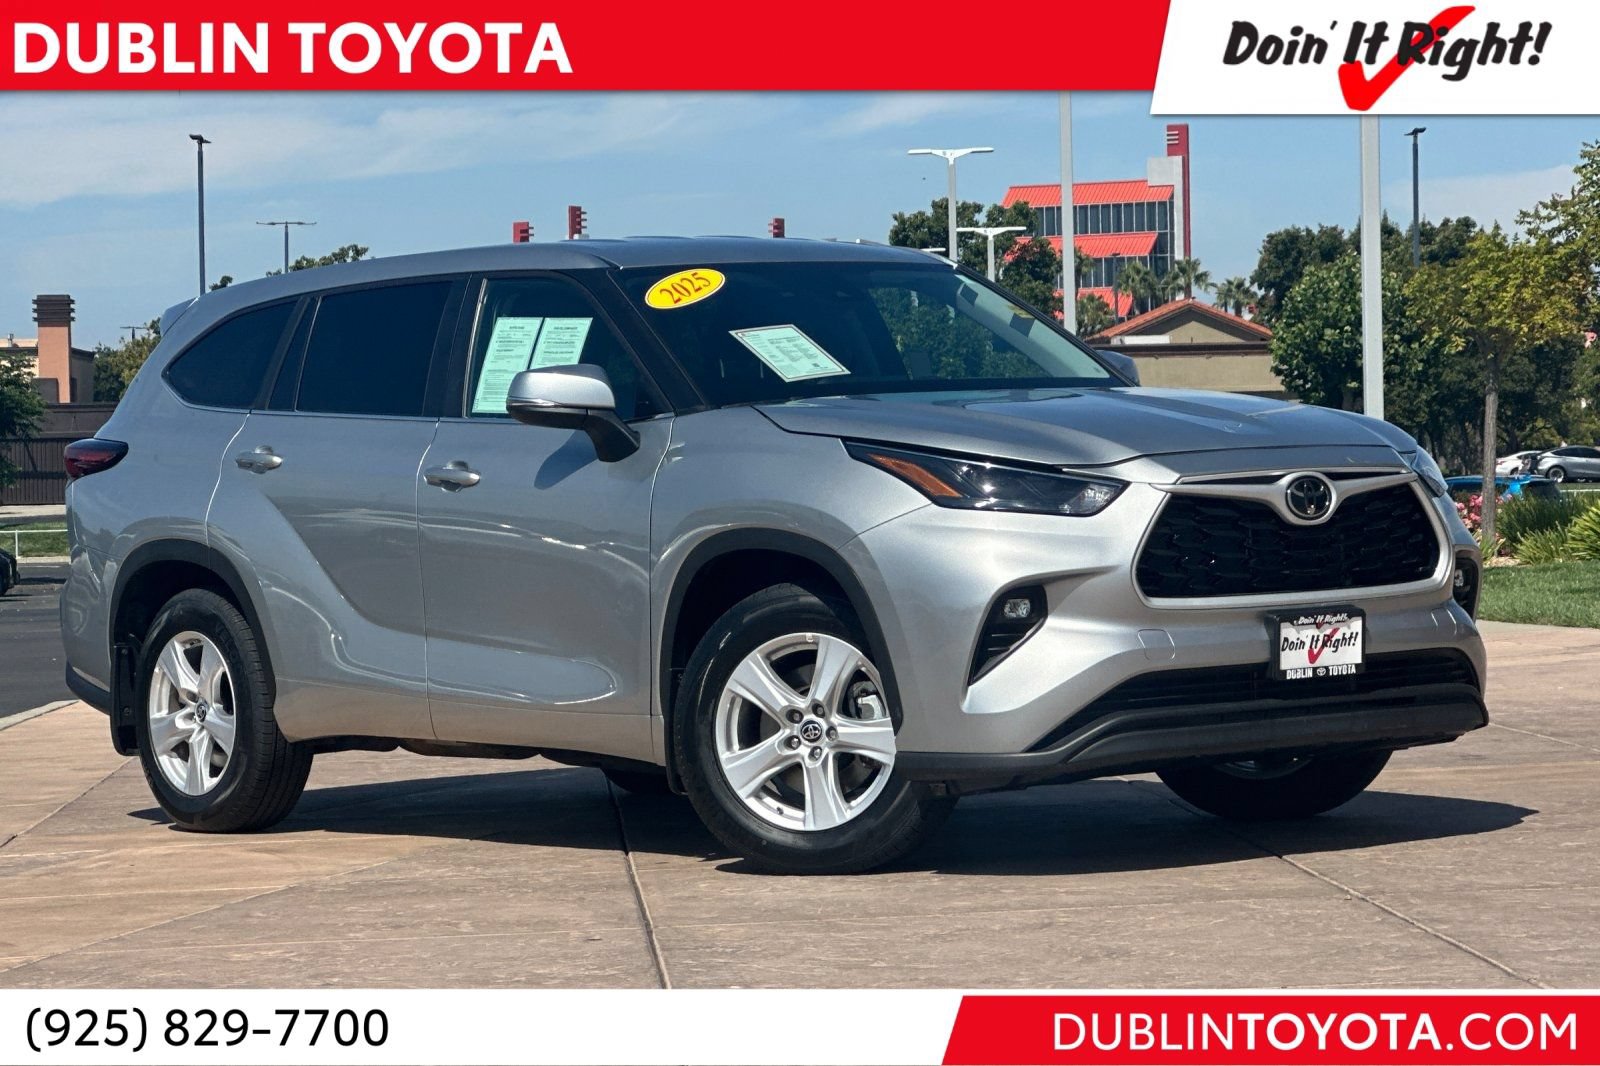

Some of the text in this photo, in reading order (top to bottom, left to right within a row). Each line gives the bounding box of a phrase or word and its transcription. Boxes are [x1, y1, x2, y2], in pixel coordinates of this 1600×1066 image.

[660, 272, 711, 304] 2025
[1281, 631, 1359, 653] Doin' It Right!
[1286, 664, 1356, 680] DUBLIN TOYOTA
